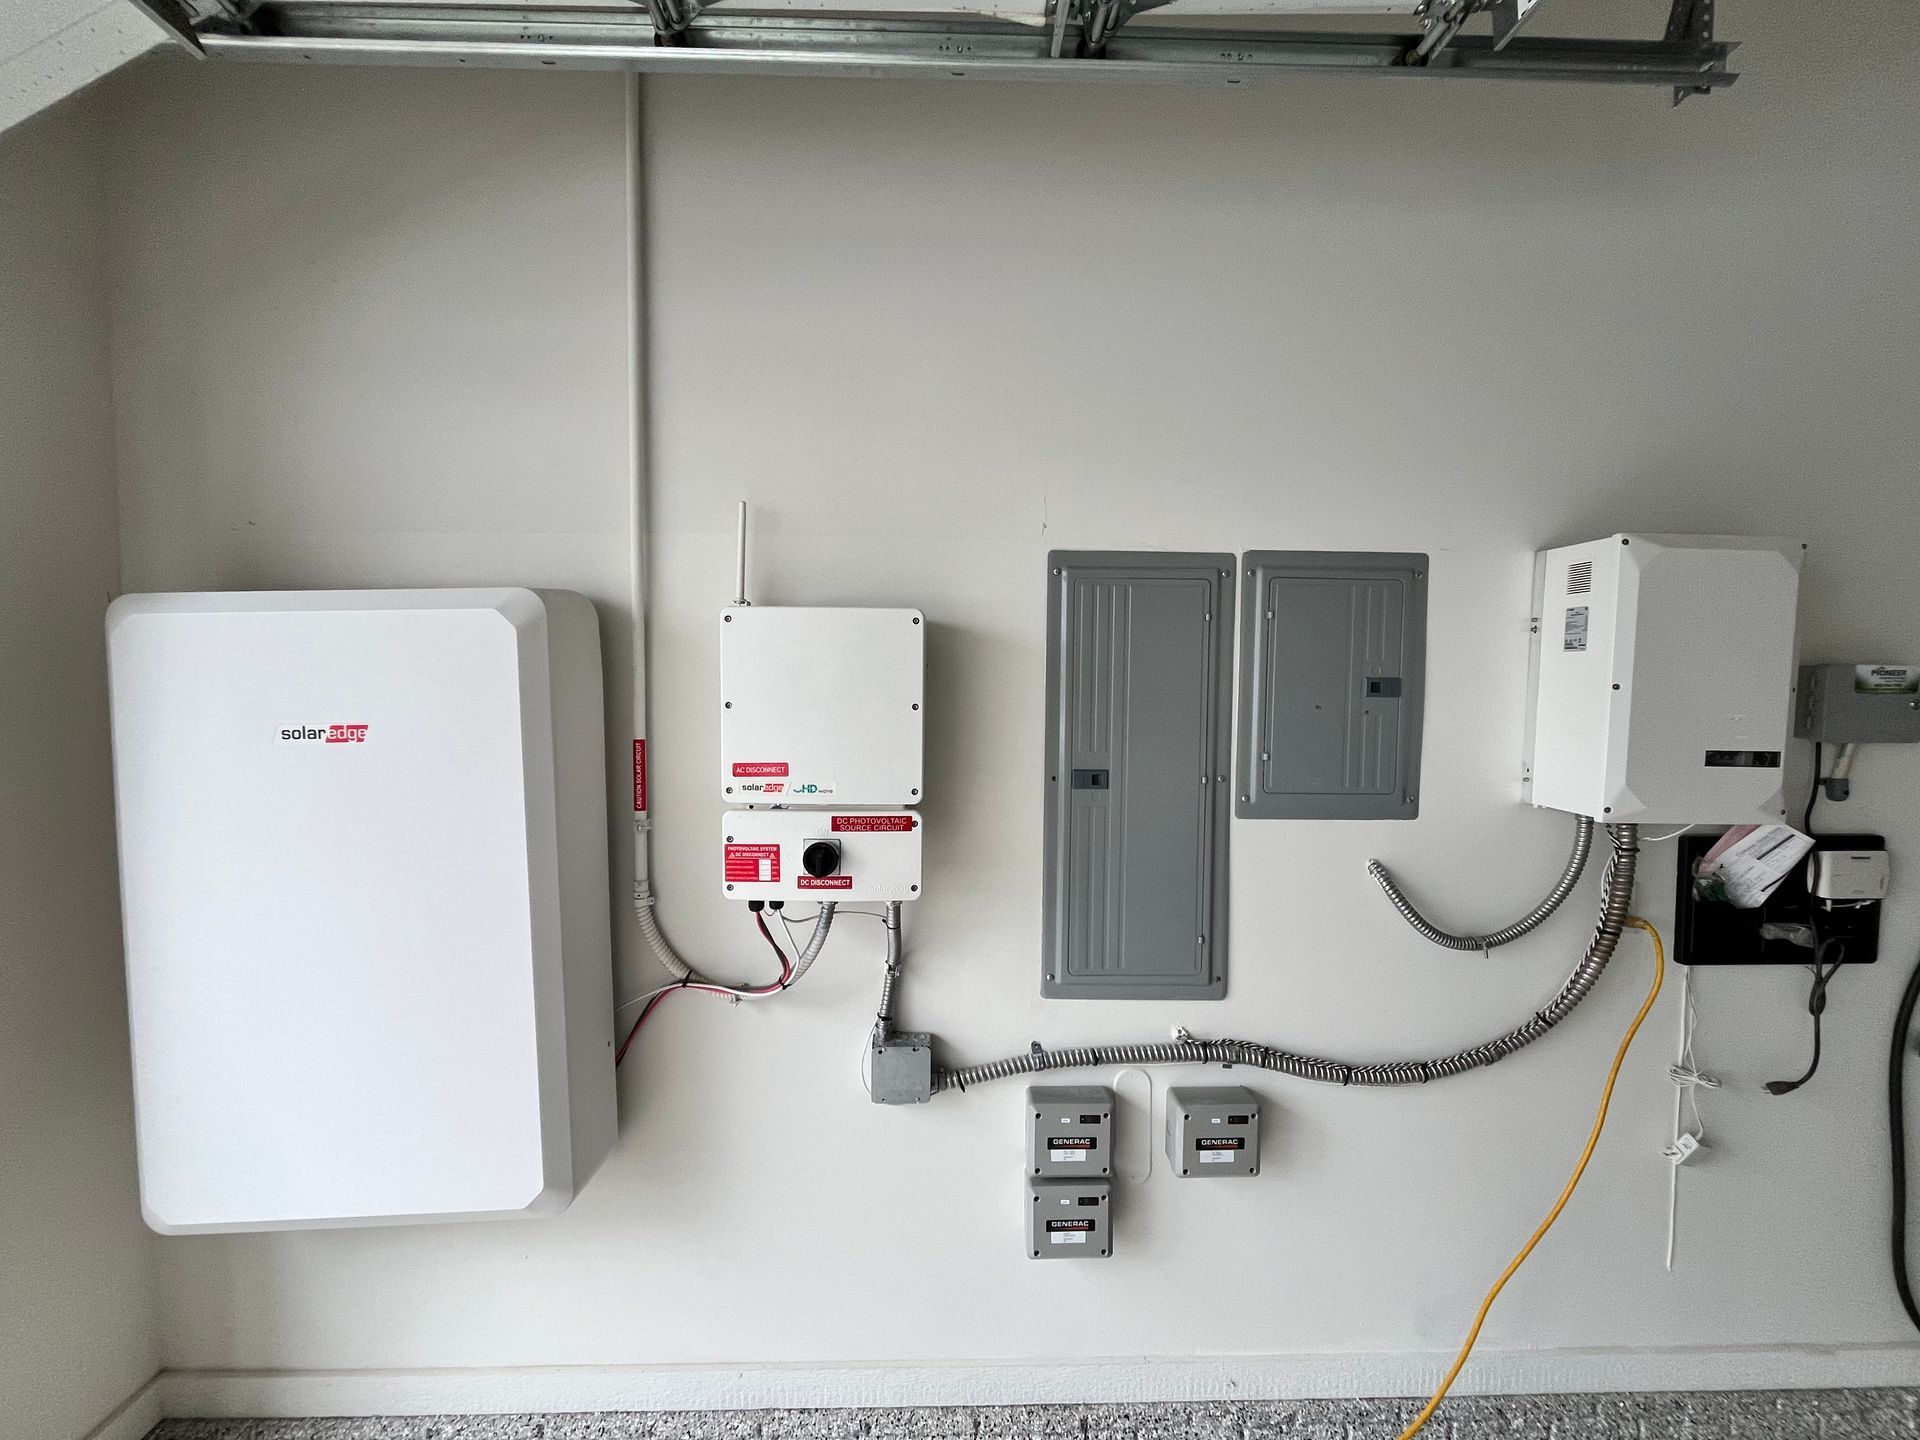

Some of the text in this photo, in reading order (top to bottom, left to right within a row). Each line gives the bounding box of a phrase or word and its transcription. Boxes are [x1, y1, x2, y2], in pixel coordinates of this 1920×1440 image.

[281, 725, 368, 743] solaredge
[736, 766, 745, 774] AC
[742, 783, 784, 793] solaredge
[849, 817, 907, 825] PHOTOVOLTAIC
[1051, 1220, 1089, 1228] GENERAC
